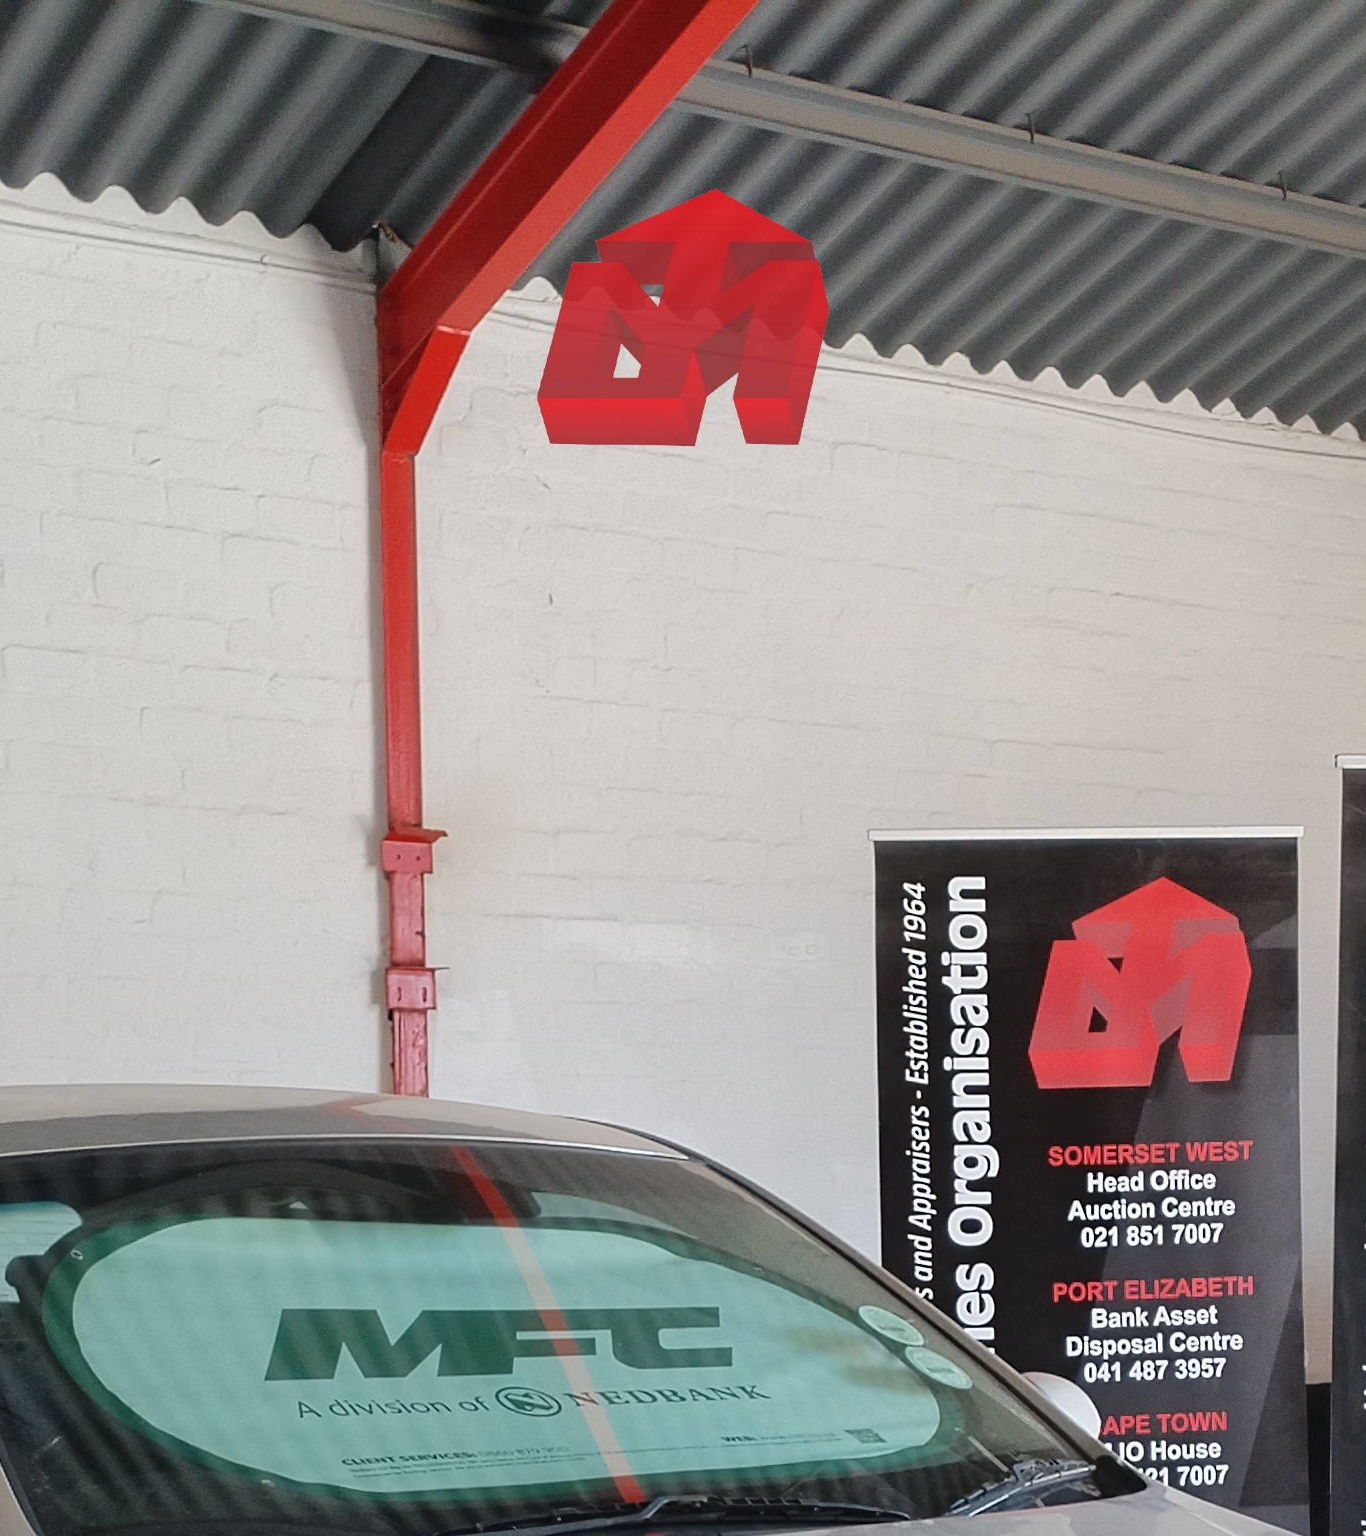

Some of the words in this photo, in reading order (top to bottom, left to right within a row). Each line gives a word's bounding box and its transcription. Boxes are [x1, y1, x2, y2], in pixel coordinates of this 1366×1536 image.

[902, 882, 926, 942] 1964
[901, 947, 929, 1085] Established
[941, 876, 1000, 1247] Organisation
[1047, 1142, 1181, 1168] SOMERSET
[1185, 1140, 1253, 1163] WEST
[905, 1105, 937, 1232] Appraisers
[1087, 1170, 1145, 1193] Head
[1149, 1169, 1217, 1191] Office
[1067, 1198, 1156, 1221] Auction
[1161, 1196, 1236, 1218] Centre
[1080, 1225, 1118, 1248] 021
[1126, 1224, 1164, 1247] 851
[1171, 1222, 1224, 1245] 7007
[907, 1233, 933, 1282] and
[1052, 1280, 1119, 1303] PORT
[1124, 1275, 1254, 1301] ELIZABETH
[1091, 1306, 1149, 1329] Bank
[1152, 1304, 1219, 1327] Asset
[264, 1305, 734, 1381] MFC
[1066, 1332, 1164, 1360] Disposal
[1169, 1331, 1244, 1353] Centre
[1083, 1361, 1121, 1384] 041
[1128, 1359, 1169, 1381] 487
[1174, 1357, 1227, 1380] 3957
[296, 1400, 323, 1419] A
[327, 1392, 452, 1416] division
[458, 1396, 494, 1413] of
[560, 1384, 772, 1409] NEDBANK
[1102, 1413, 1151, 1436] APE
[1156, 1411, 1228, 1434] TOWN
[1150, 1439, 1222, 1461] House
[1176, 1464, 1230, 1487] 7007
